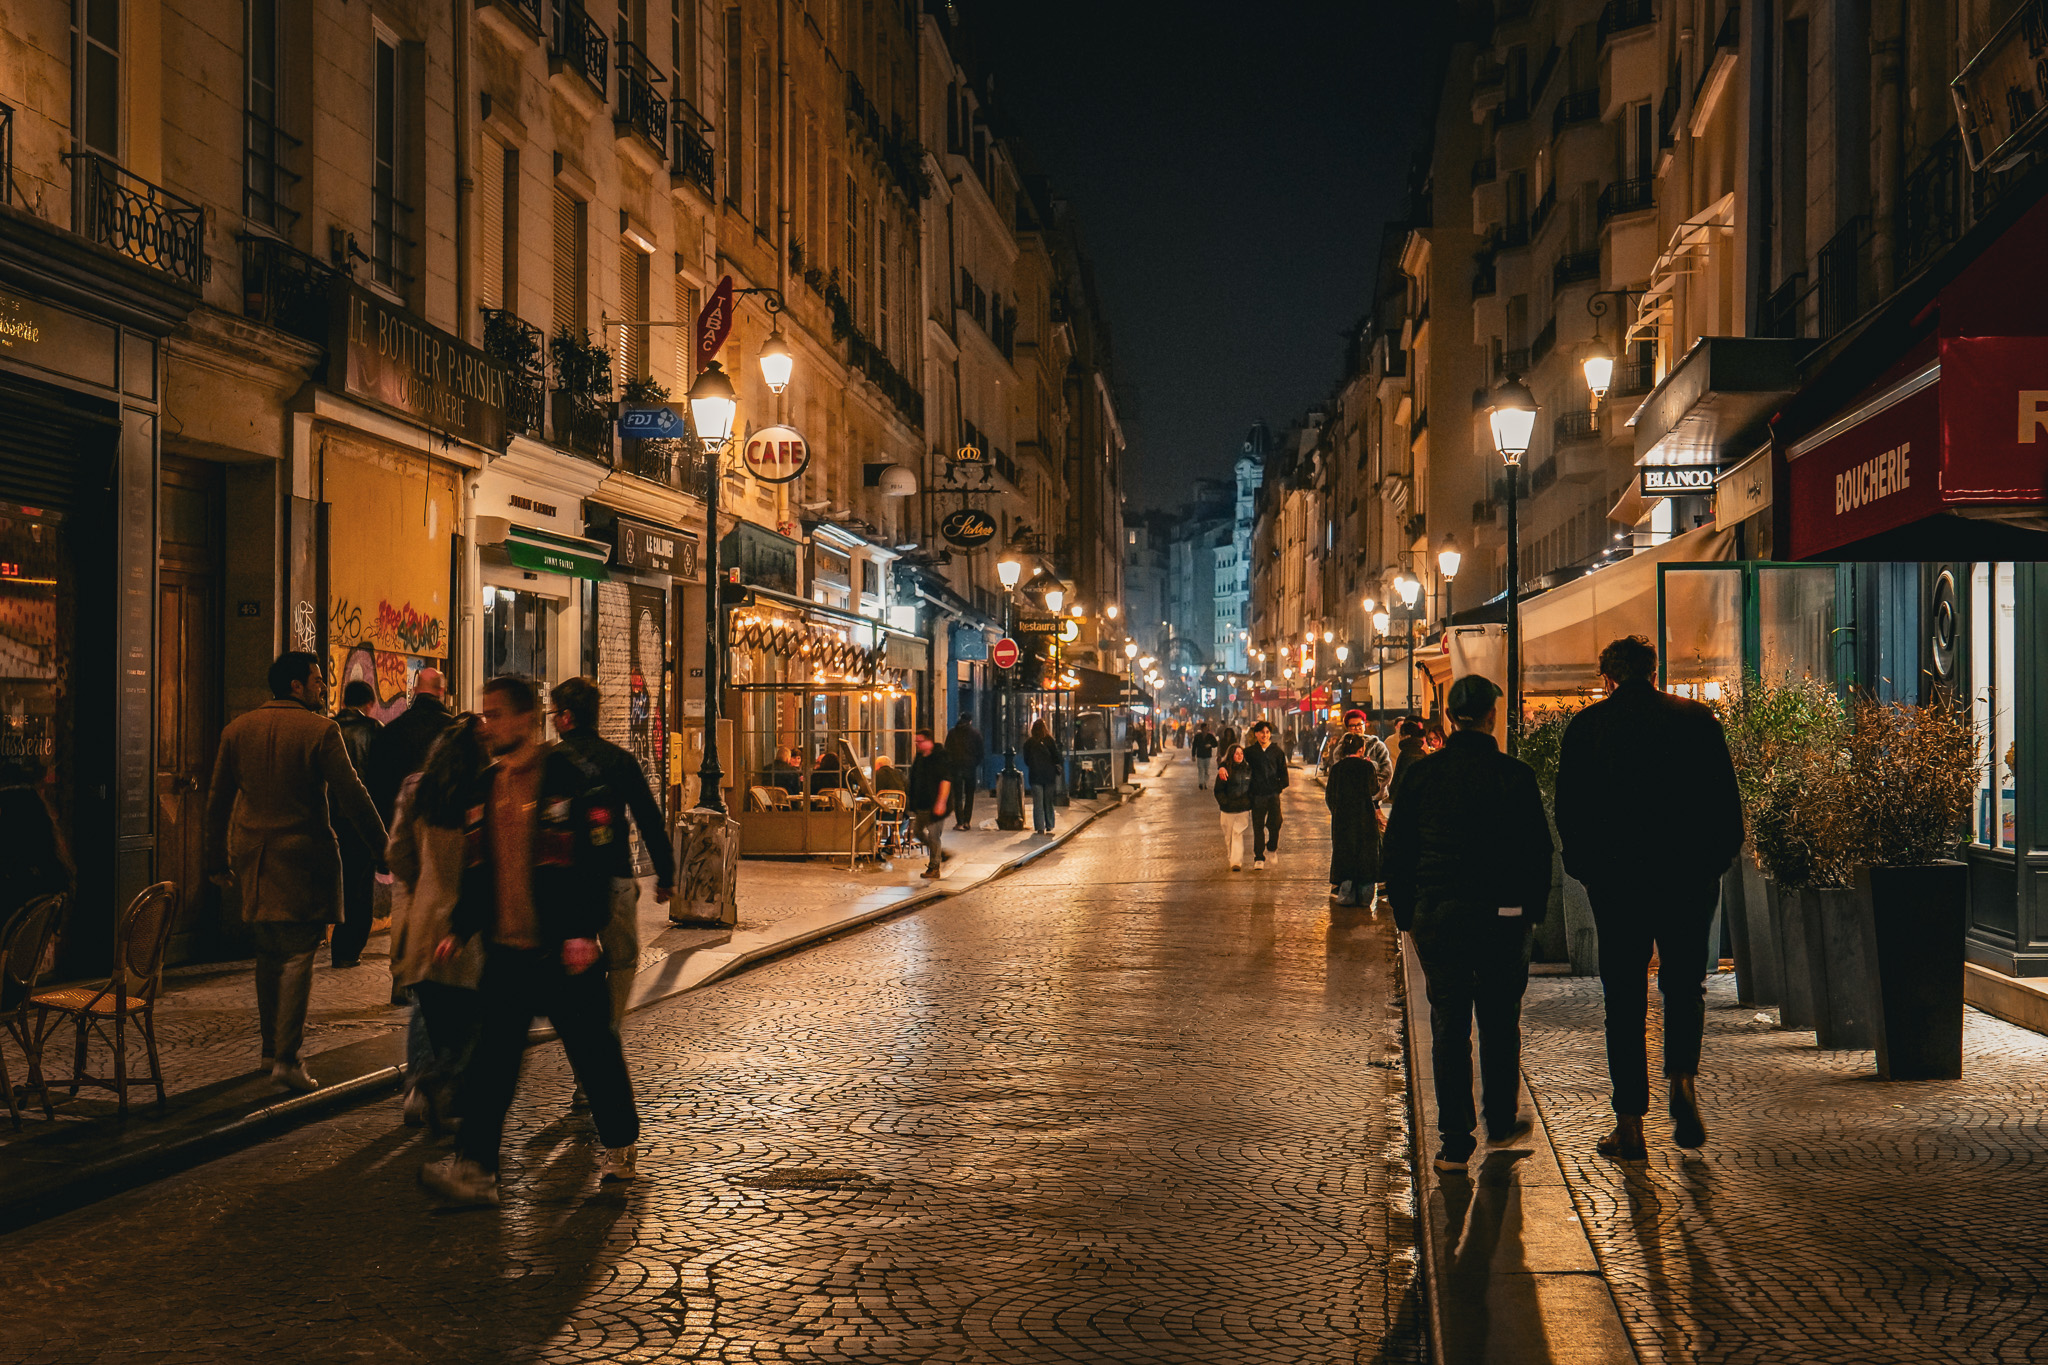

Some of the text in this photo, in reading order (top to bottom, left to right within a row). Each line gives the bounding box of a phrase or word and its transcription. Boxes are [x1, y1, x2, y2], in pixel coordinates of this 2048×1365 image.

[702, 296, 727, 351] TABAC
[350, 295, 505, 409] LE BOTTIER PARISIEN
[400, 374, 466, 428] CORDONNERIE
[627, 413, 652, 425] FDJ
[747, 440, 802, 465] CAFE
[1645, 471, 1713, 487] BIANCO
[1836, 442, 1910, 515] BOUCHERIE
[544, 556, 574, 570] JIMMY FAIRLY
